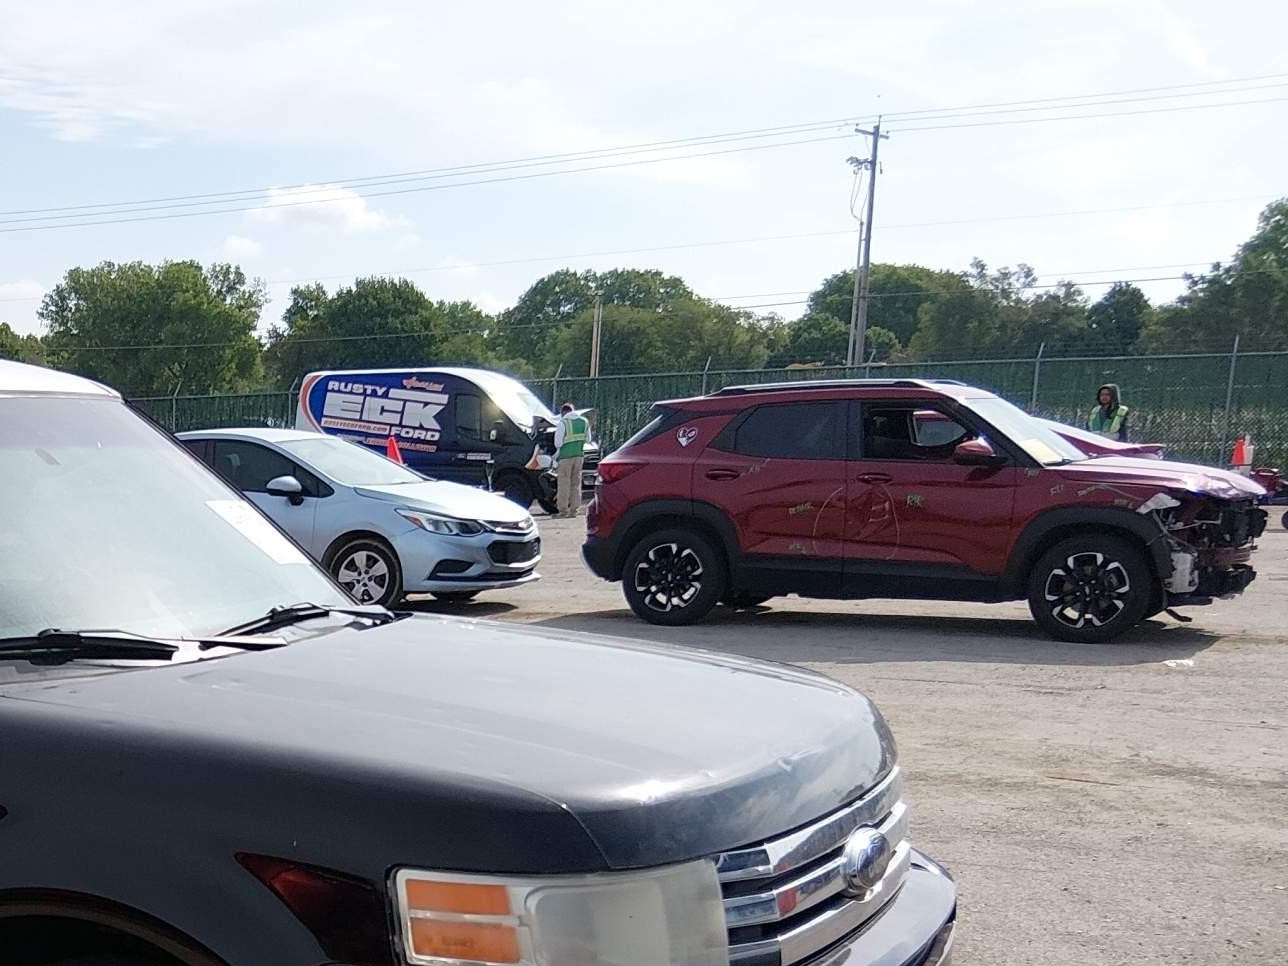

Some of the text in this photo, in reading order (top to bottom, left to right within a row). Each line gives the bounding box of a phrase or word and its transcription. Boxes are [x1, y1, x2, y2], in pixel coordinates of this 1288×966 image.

[328, 380, 388, 396] RUSTY
[322, 390, 447, 430] ECK
[391, 426, 441, 441] FORD
